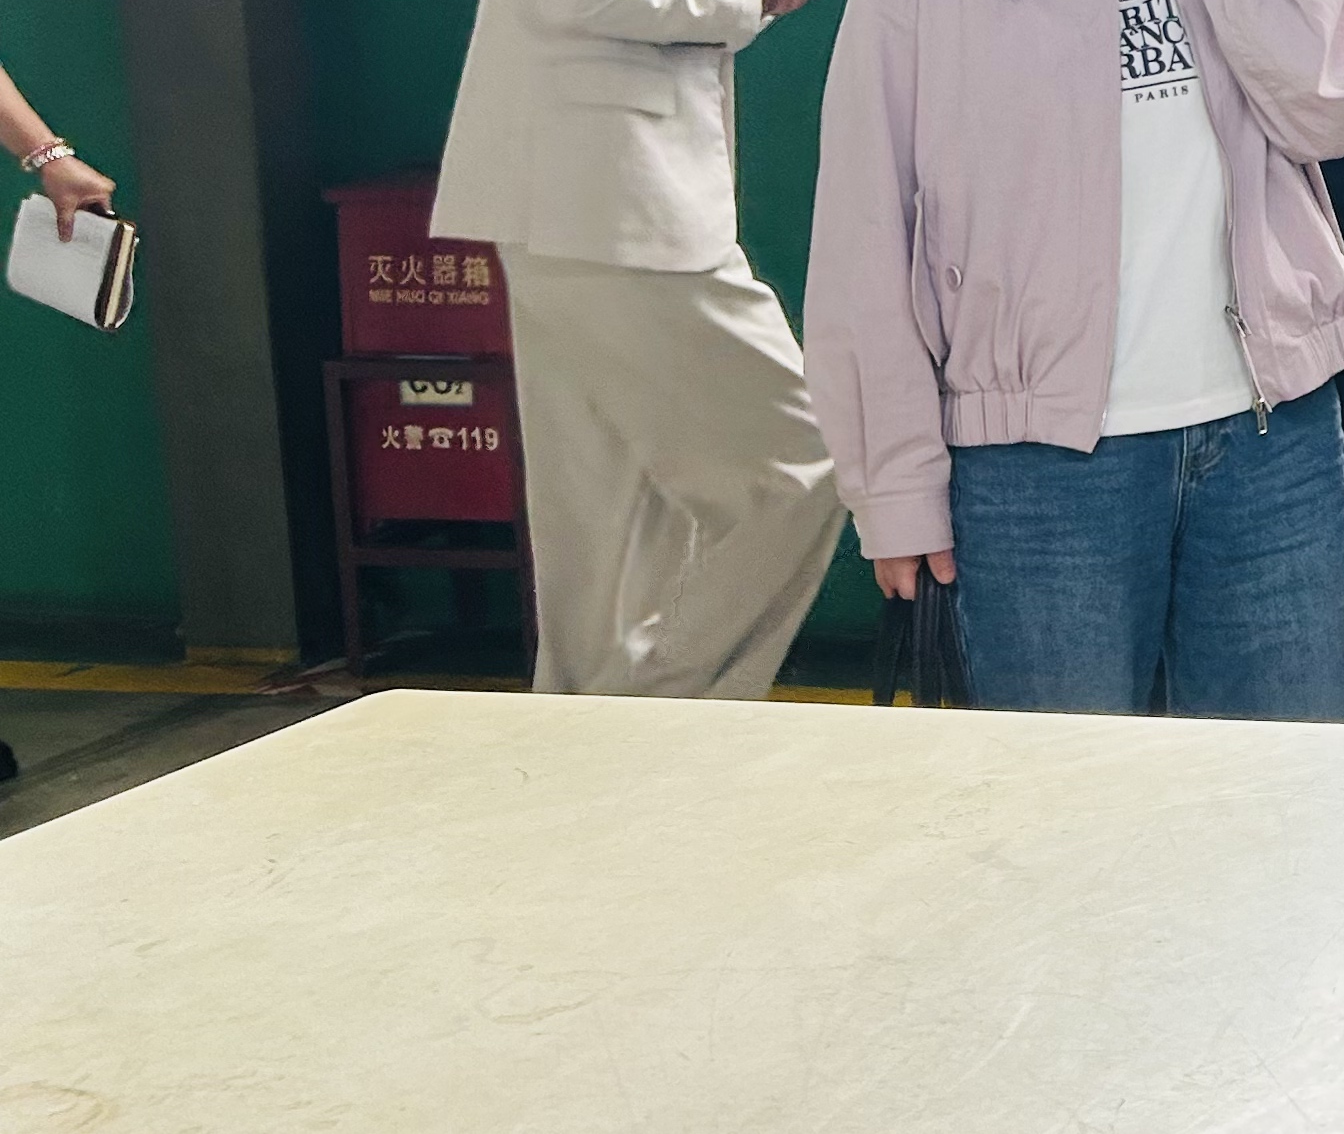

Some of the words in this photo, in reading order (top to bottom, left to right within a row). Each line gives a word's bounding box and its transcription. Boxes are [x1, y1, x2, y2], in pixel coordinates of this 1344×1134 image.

[1134, 85, 1189, 103] PARIS
[368, 254, 489, 287] 灭火器箱
[382, 425, 424, 450] 火警
[457, 426, 498, 451] 119
